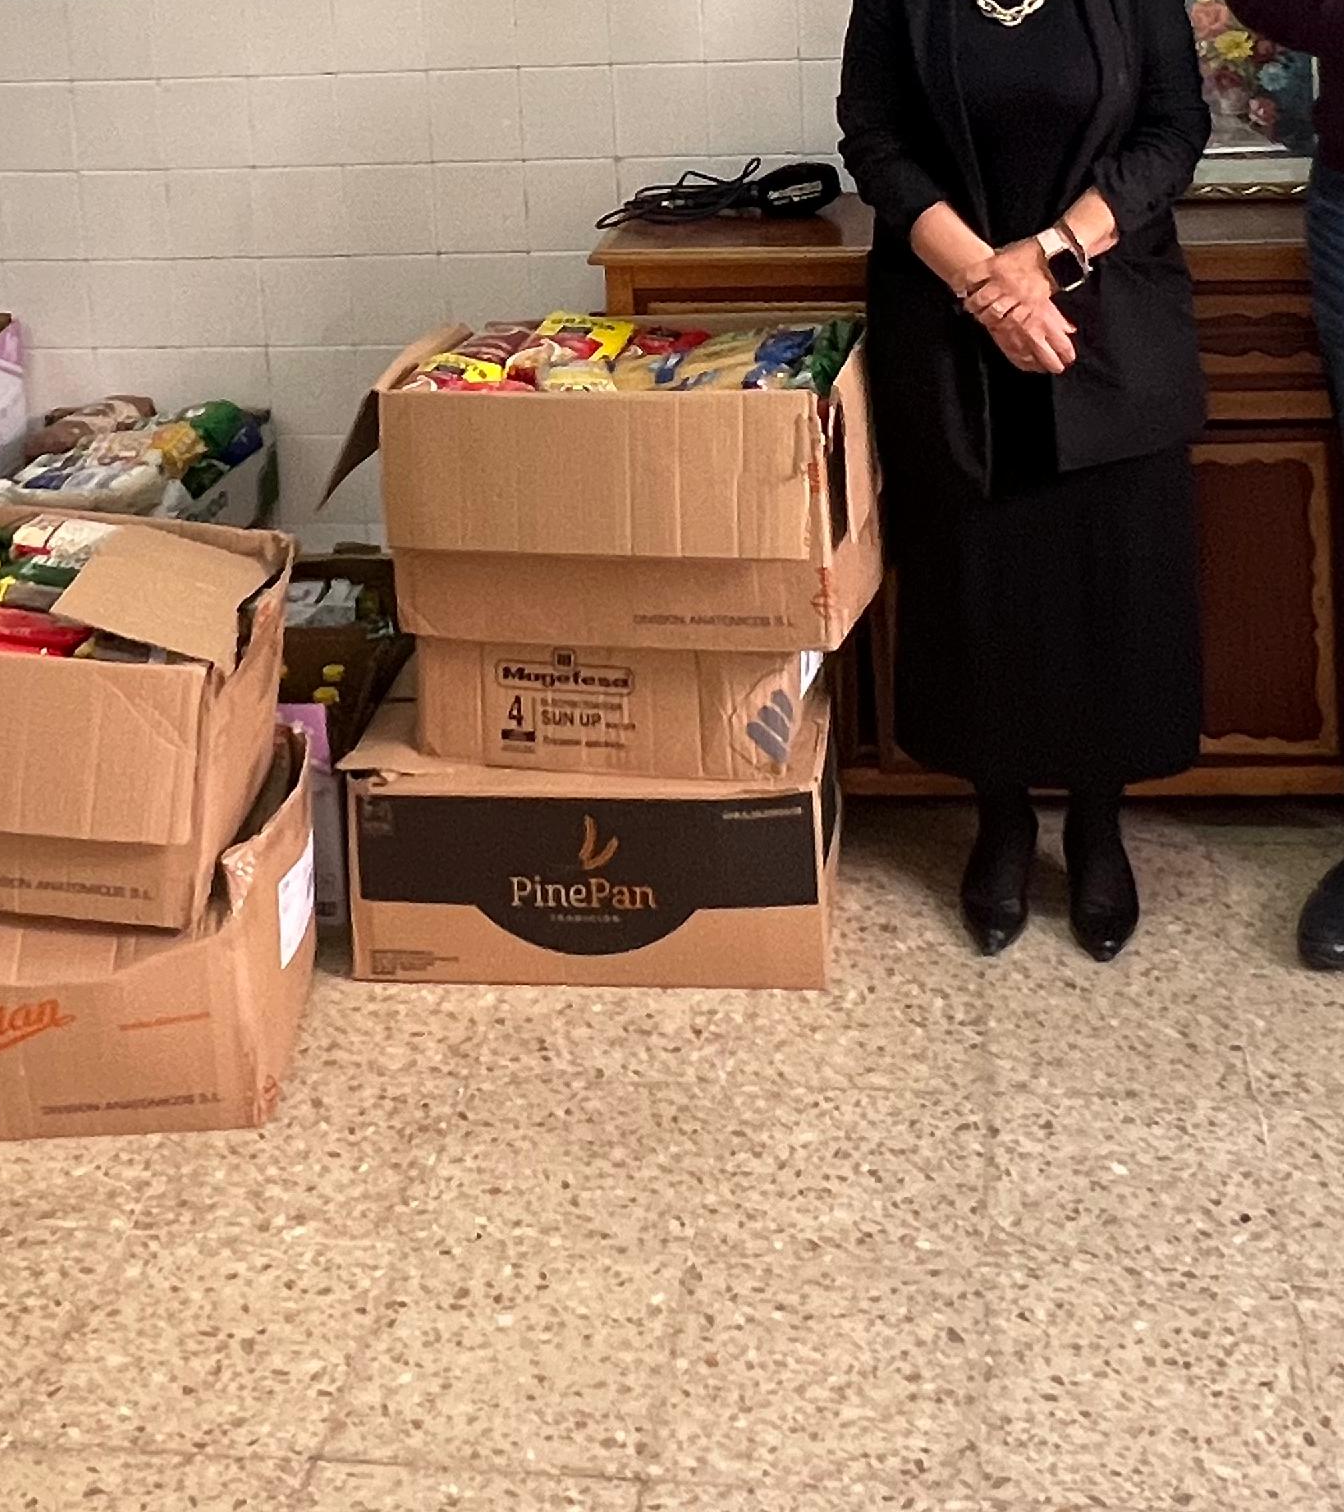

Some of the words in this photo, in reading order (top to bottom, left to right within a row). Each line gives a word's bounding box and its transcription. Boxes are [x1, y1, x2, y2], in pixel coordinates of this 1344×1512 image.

[507, 694, 524, 727] 4
[540, 709, 574, 728] SUN
[579, 711, 602, 728] UP
[509, 874, 656, 911] PinePan
